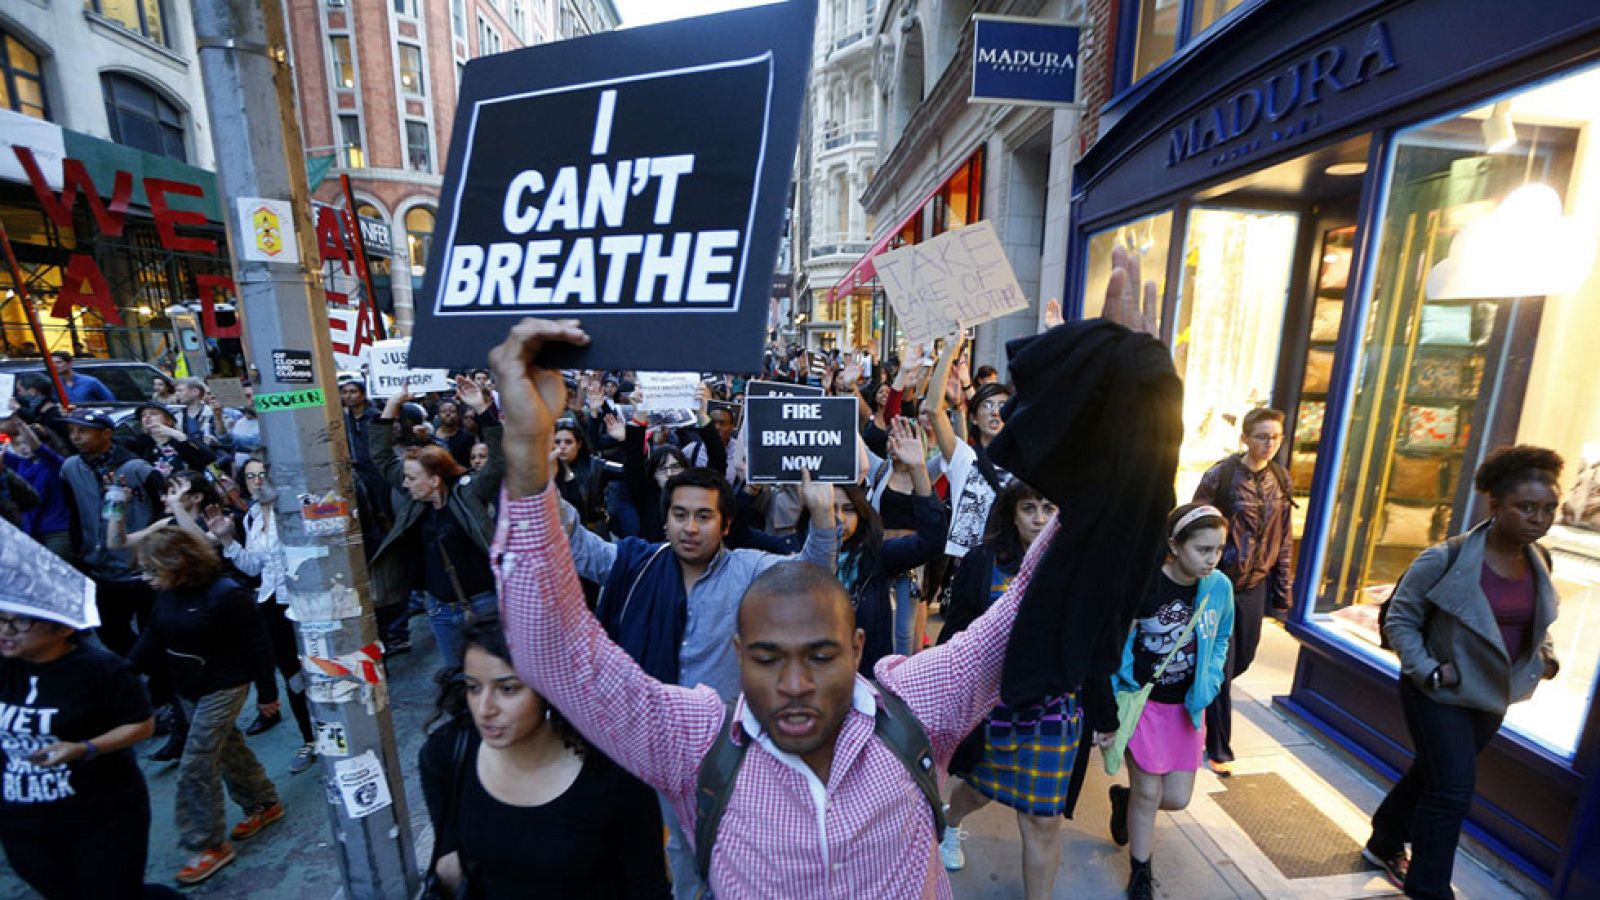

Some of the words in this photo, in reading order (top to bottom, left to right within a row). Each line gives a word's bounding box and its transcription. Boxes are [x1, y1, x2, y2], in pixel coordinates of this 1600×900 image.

[978, 48, 1074, 69] MADURA
[1164, 20, 1399, 168] MADURA
[590, 89, 617, 155] I
[11, 144, 218, 254] WE
[502, 154, 695, 234] CAN'T
[442, 230, 740, 306] BREATHE
[876, 226, 1001, 291] TAKE
[895, 277, 949, 316] CARE
[960, 270, 997, 294] OF
[782, 403, 823, 419] FIRE
[761, 430, 842, 446] BRATTON
[781, 455, 823, 471] NOW
[25, 675, 40, 705] I
[4, 770, 77, 802] BLACK
